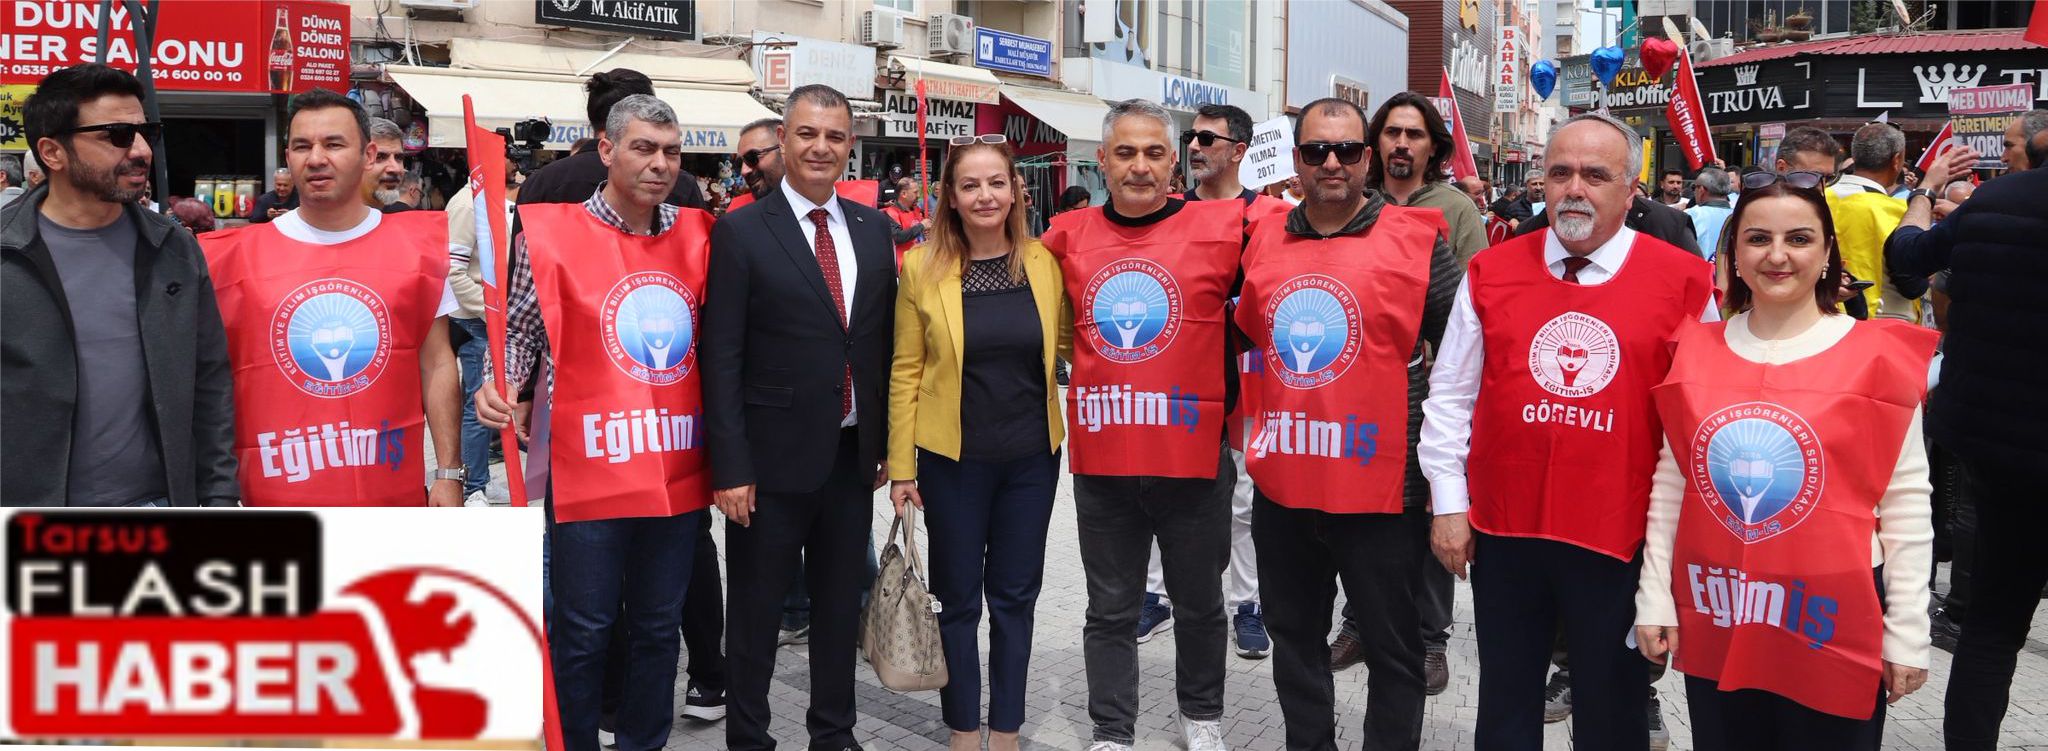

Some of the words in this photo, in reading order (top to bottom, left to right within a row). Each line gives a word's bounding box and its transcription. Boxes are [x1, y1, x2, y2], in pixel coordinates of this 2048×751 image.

[15, 0, 148, 31] DÜNY
[302, 15, 342, 30] DÜNYA
[613, 1, 645, 21] Akif
[645, 2, 679, 25] ATİK
[301, 30, 342, 45] DÖNER
[80, 37, 243, 68] SAONU
[297, 46, 345, 60] SALONU
[1501, 29, 1515, 85] BAHAR
[12, 64, 49, 76] 0535
[172, 69, 200, 80] 600
[203, 71, 223, 81] 00
[226, 72, 242, 82] 10
[1615, 71, 1661, 87] KLA
[1590, 82, 1635, 108] Pone
[1636, 84, 1672, 105] Offic
[1708, 86, 1786, 113] TRUVA
[1949, 92, 1975, 110] MEB
[680, 130, 728, 147] ANTA
[1005, 115, 1031, 148] MY
[1249, 146, 1277, 164] YILMAZ
[1257, 164, 1275, 179] 2017
[280, 293, 305, 319] BİLİM
[610, 282, 632, 307] BİLİM
[1086, 294, 1093, 306] VE
[1090, 271, 1111, 293] BİLİM
[1163, 287, 1179, 339] SENDİKASI
[607, 308, 614, 320] VE
[276, 322, 285, 335] VE
[375, 311, 389, 368] SENDİKASI
[1340, 308, 1358, 364] SENDİKASI
[605, 324, 625, 360] EĞİTİM
[1533, 340, 1540, 350] VE
[1539, 320, 1559, 339] BİLİM
[1601, 338, 1616, 382] SENDİKASI
[276, 338, 298, 375] EĞİTİM
[1543, 380, 1594, 396] EĞİTİM-İŞ
[1522, 399, 1614, 433] GÖREVLİ
[1700, 415, 1727, 443] BİLİM
[1696, 445, 1704, 459] VE
[1697, 464, 1719, 507] EĞİTİM
[1791, 448, 1819, 516] SENDİKASI
